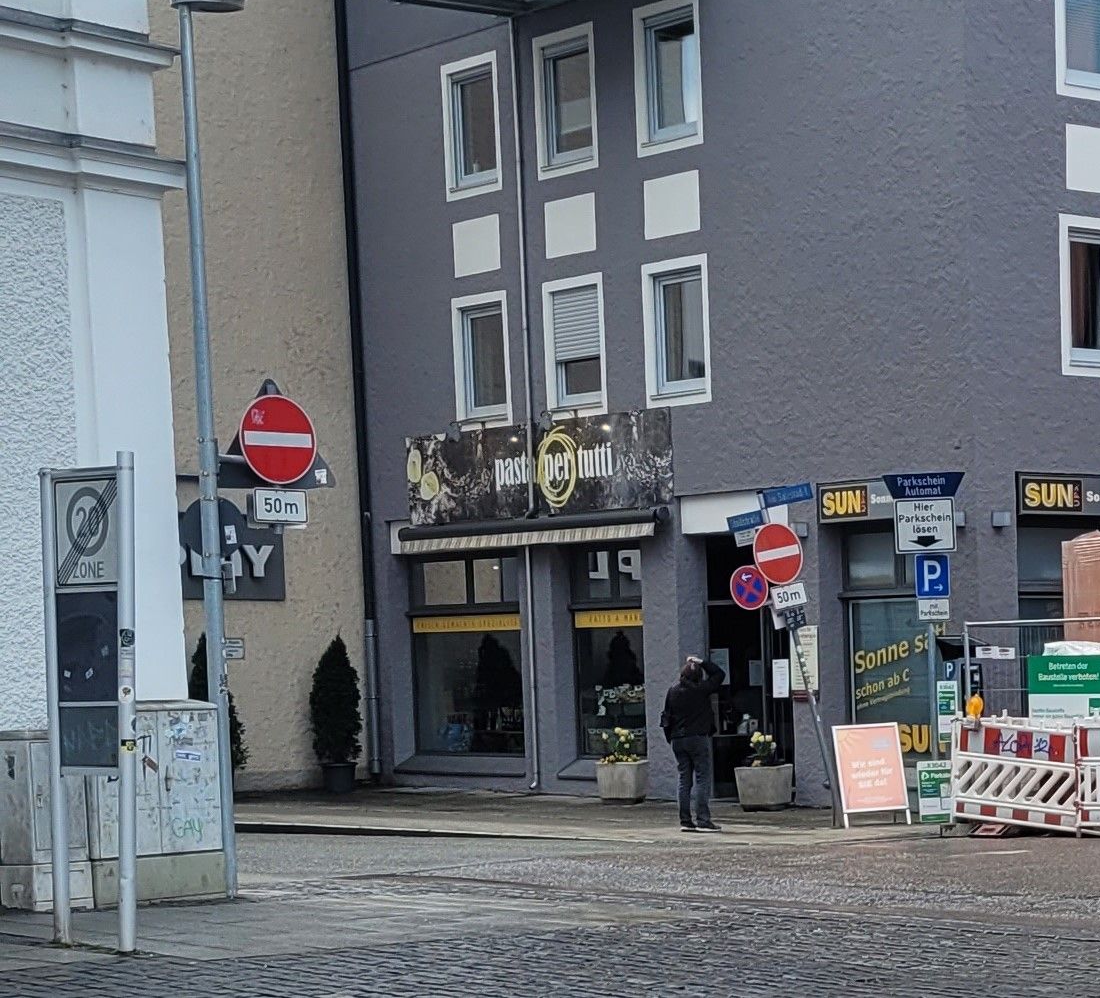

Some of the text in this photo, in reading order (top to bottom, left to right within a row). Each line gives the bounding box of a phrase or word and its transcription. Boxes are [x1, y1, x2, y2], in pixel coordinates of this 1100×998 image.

[544, 452, 570, 487] per
[577, 442, 613, 479] tutti
[897, 474, 946, 487] Parkschein
[905, 486, 941, 496] Automat
[1025, 482, 1074, 508] SUN
[822, 489, 861, 516] SUN
[914, 502, 934, 512] Hier
[898, 513, 952, 523] Parkschein
[72, 561, 104, 579] ZONE
[923, 560, 942, 592] P
[855, 639, 910, 674] Sonne
[946, 663, 954, 678] P
[1048, 662, 1088, 670] Betreten der
[1038, 672, 1100, 681] Baustelle verboten!
[855, 678, 884, 700] schon
[888, 673, 900, 688] ab
